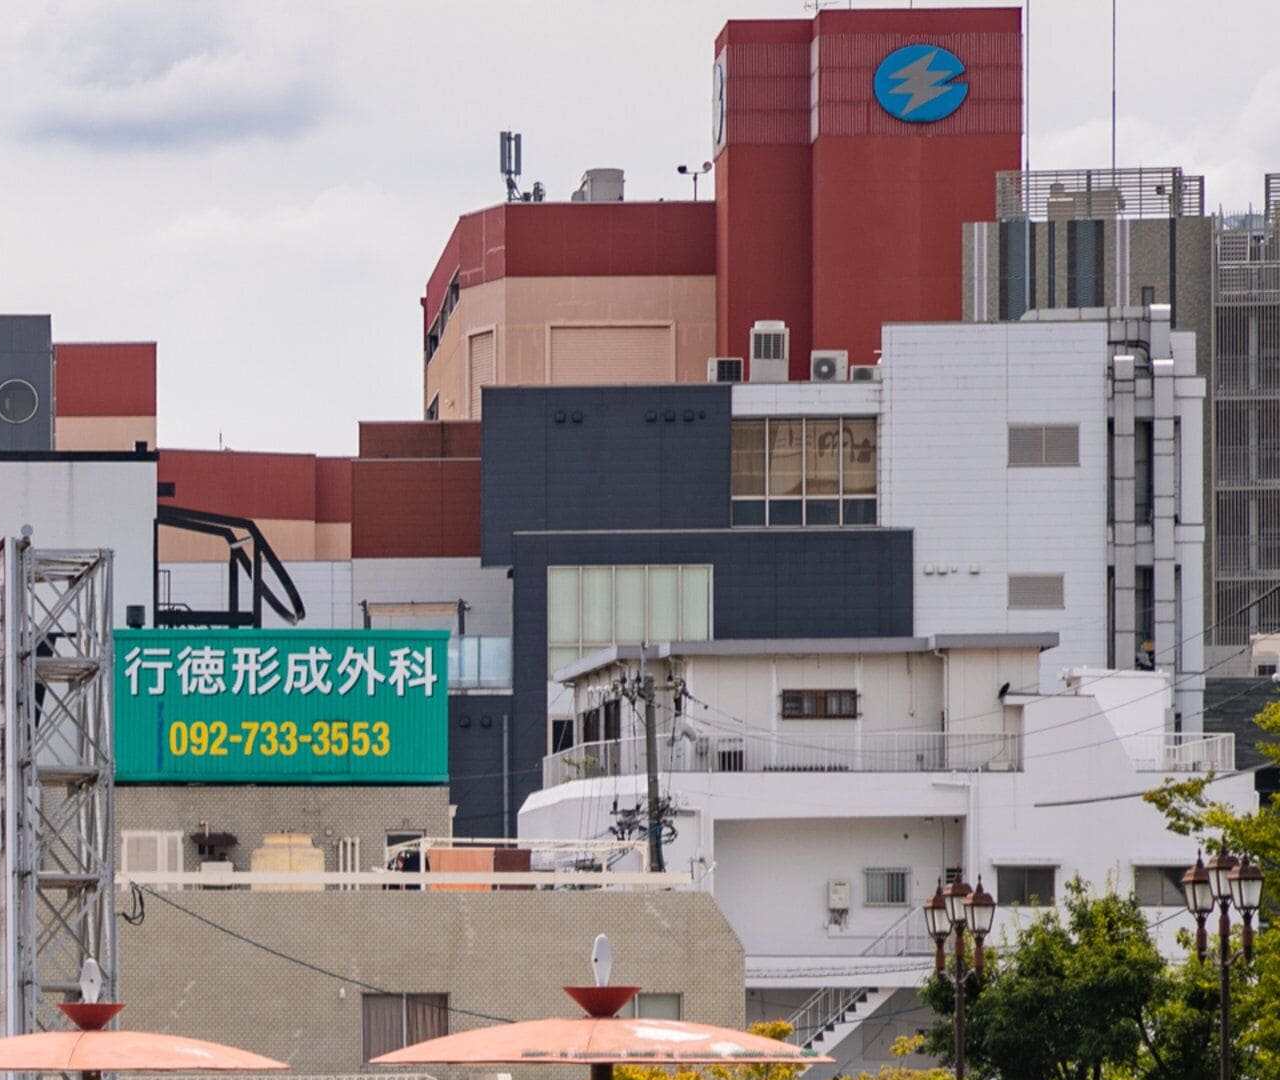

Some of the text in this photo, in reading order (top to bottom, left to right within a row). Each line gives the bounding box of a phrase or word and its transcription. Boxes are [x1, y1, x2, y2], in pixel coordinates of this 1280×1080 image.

[124, 645, 438, 697] 行徳形成外科
[169, 720, 390, 757] 092-733-3553
